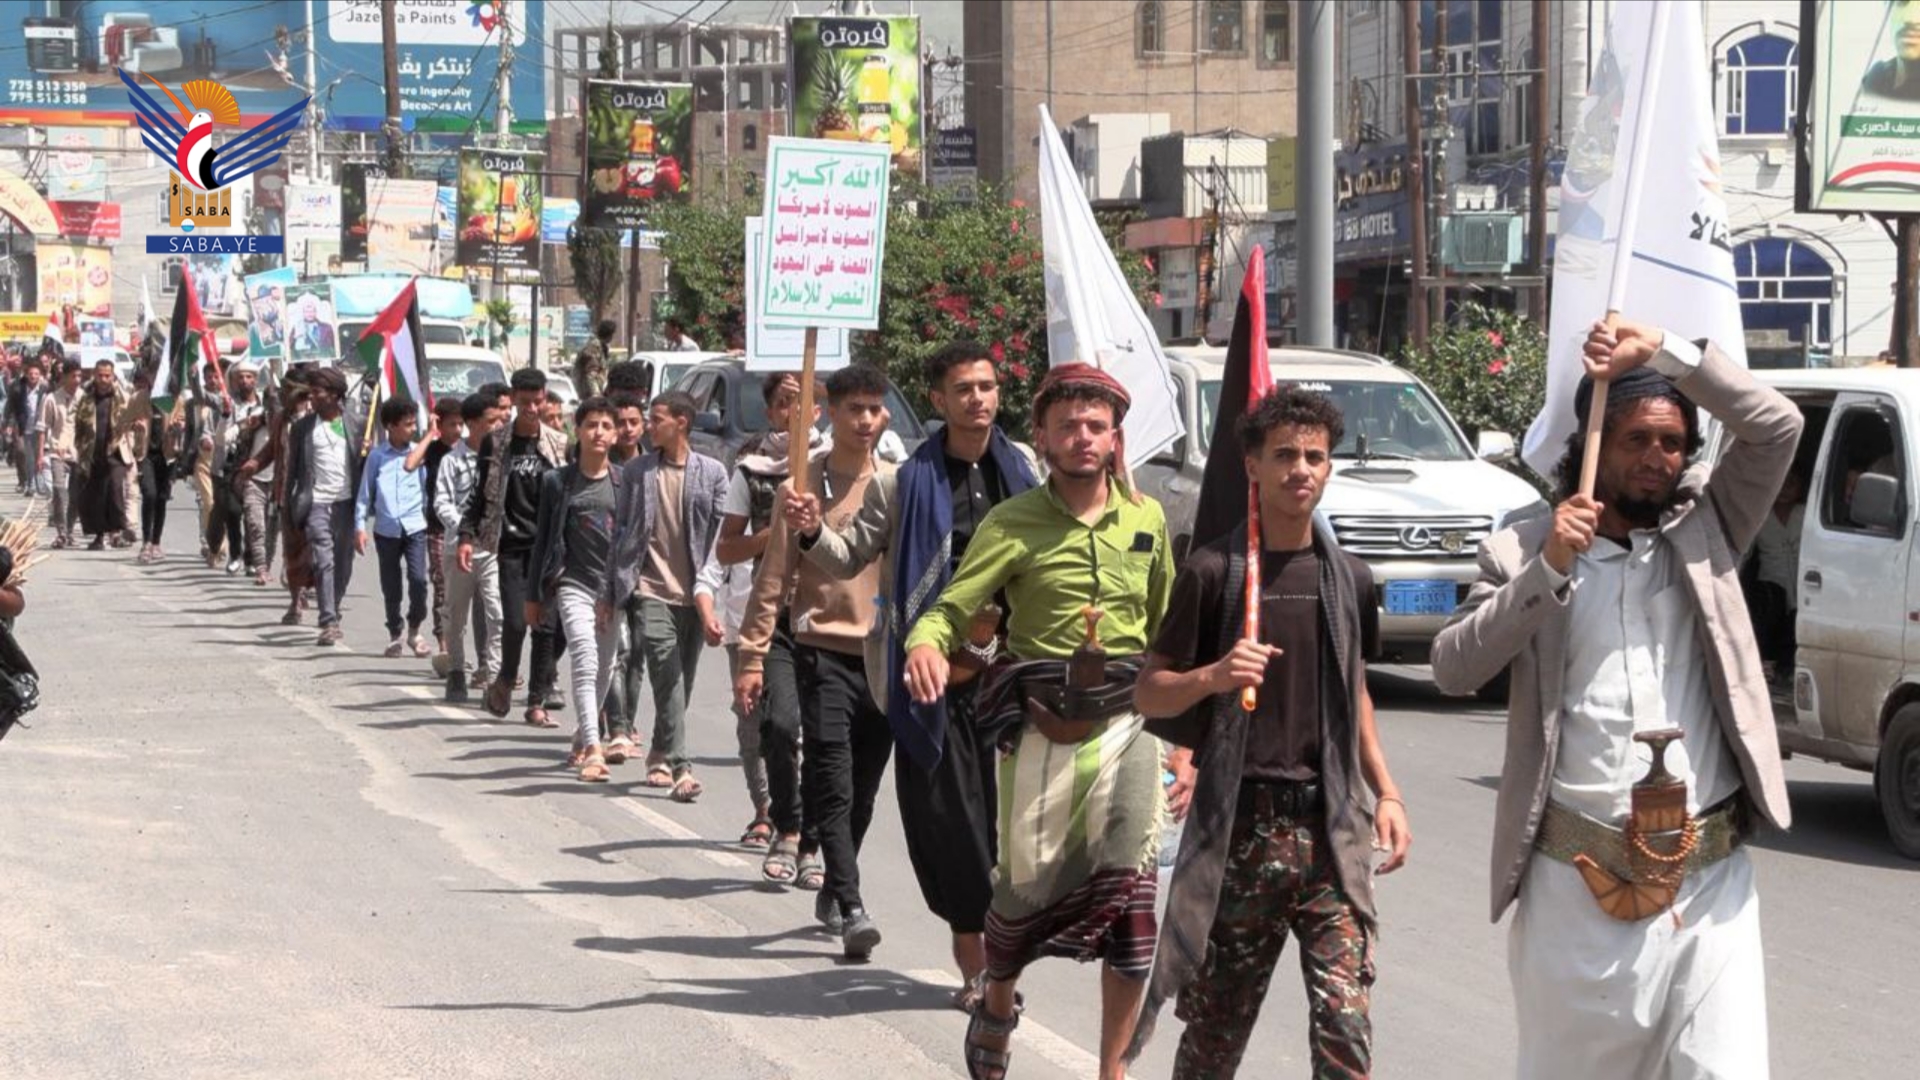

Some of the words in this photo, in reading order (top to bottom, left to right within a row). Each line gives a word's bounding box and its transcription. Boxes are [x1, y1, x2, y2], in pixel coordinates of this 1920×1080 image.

[346, 11, 405, 23] Jazea
[410, 11, 457, 24] Paints
[820, 22, 887, 47] فروتو
[427, 57, 472, 79] نبتكر
[9, 79, 33, 91] 775
[37, 80, 60, 91] 513
[9, 91, 33, 103] 775
[454, 101, 472, 111] Art
[613, 90, 666, 109] فروتو
[483, 157, 525, 171] فروتو
[780, 156, 841, 193] أكبر
[842, 164, 881, 188] الله
[834, 200, 876, 220] الموت
[1343, 216, 1360, 241] IBB
[1361, 211, 1396, 238] HOTEL
[832, 228, 875, 249] الموت
[772, 254, 810, 276] اليهود
[813, 259, 835, 276] على
[840, 256, 873, 275] اللعنة
[825, 281, 870, 310] النصر
